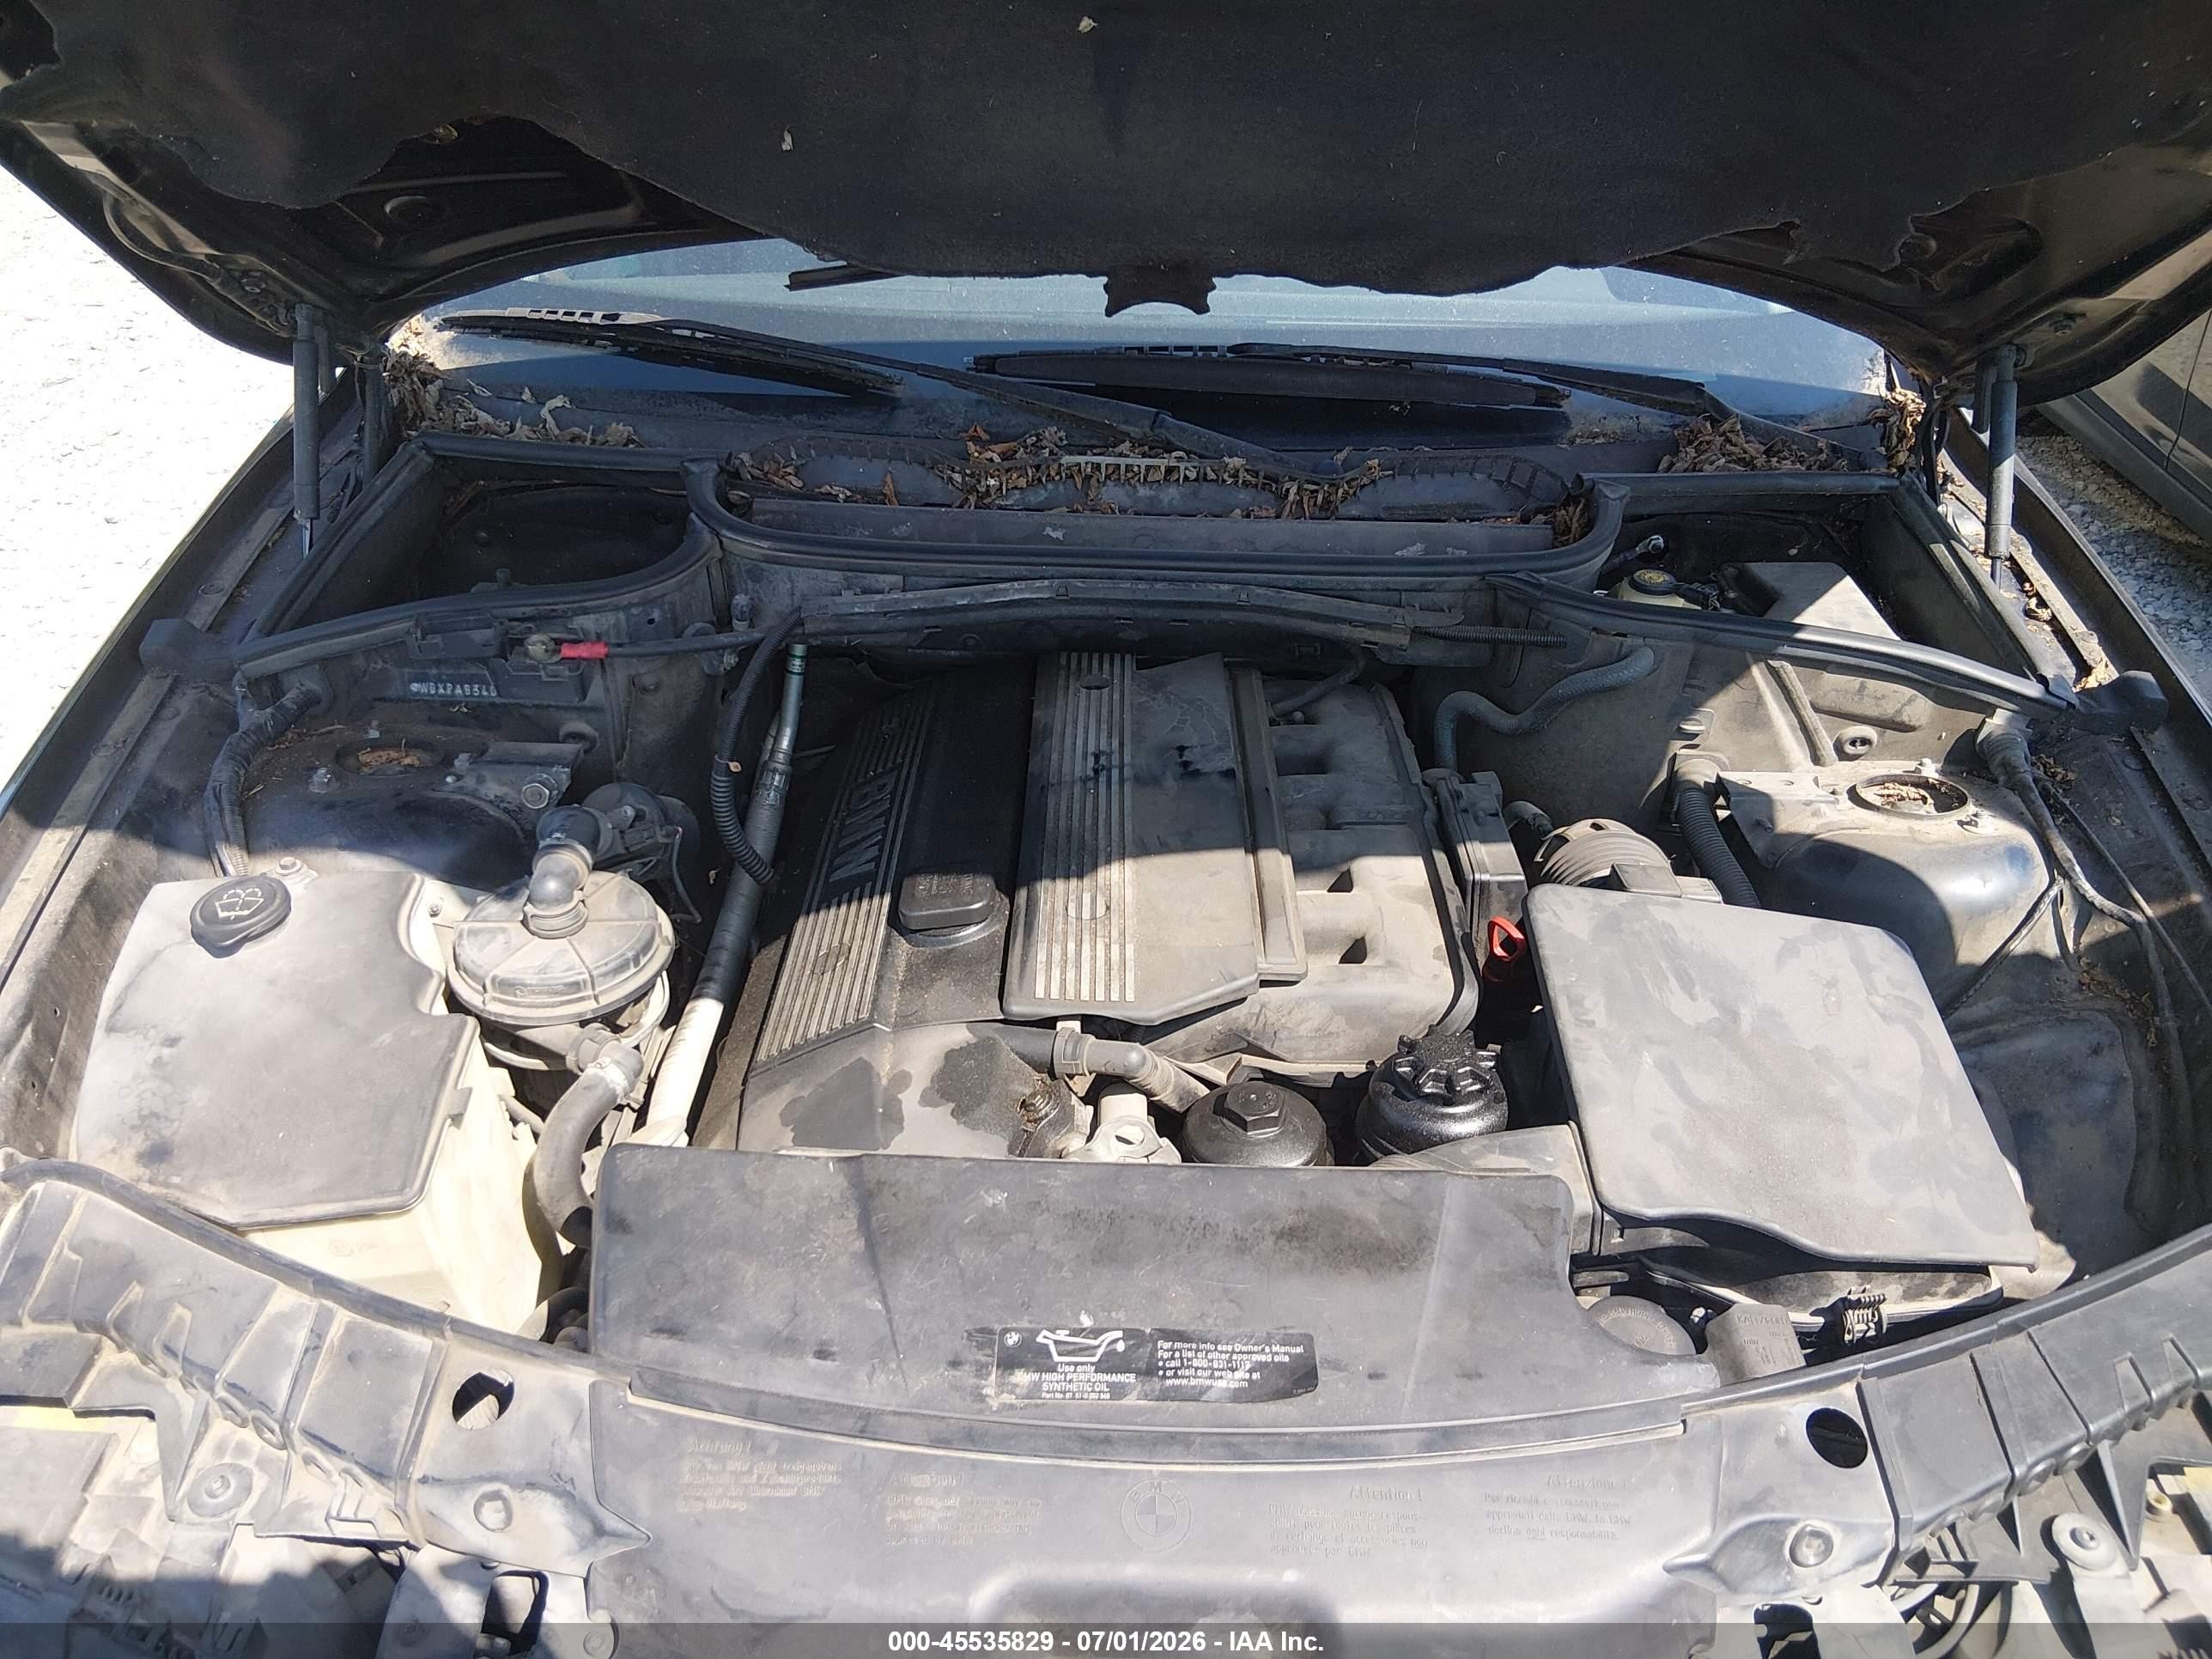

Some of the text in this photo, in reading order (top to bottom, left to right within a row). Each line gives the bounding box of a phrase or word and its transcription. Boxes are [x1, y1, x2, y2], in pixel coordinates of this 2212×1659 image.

[1157, 1340, 1173, 1350] For
[1174, 1341, 1197, 1350] more
[1199, 1341, 1215, 1351] info
[1234, 1343, 1270, 1352] Owner's
[1272, 1344, 1304, 1353] Manual
[1158, 1350, 1173, 1358] For
[1182, 1350, 1196, 1358] list
[1197, 1350, 1206, 1358] of
[1206, 1351, 1231, 1360] other
[1232, 1352, 1272, 1362] approved
[1273, 1354, 1290, 1363] oils
[1165, 1358, 1181, 1367] call
[1058, 1364, 1096, 1374] Use only
[1177, 1368, 1195, 1376] visit
[1042, 1372, 1065, 1382] HIGH
[1066, 1372, 1137, 1382] PERFORMANCE
[1166, 1376, 1249, 1388] www.bmwusa.com
[1042, 1382, 1110, 1392] SYNTHETIC OIL
